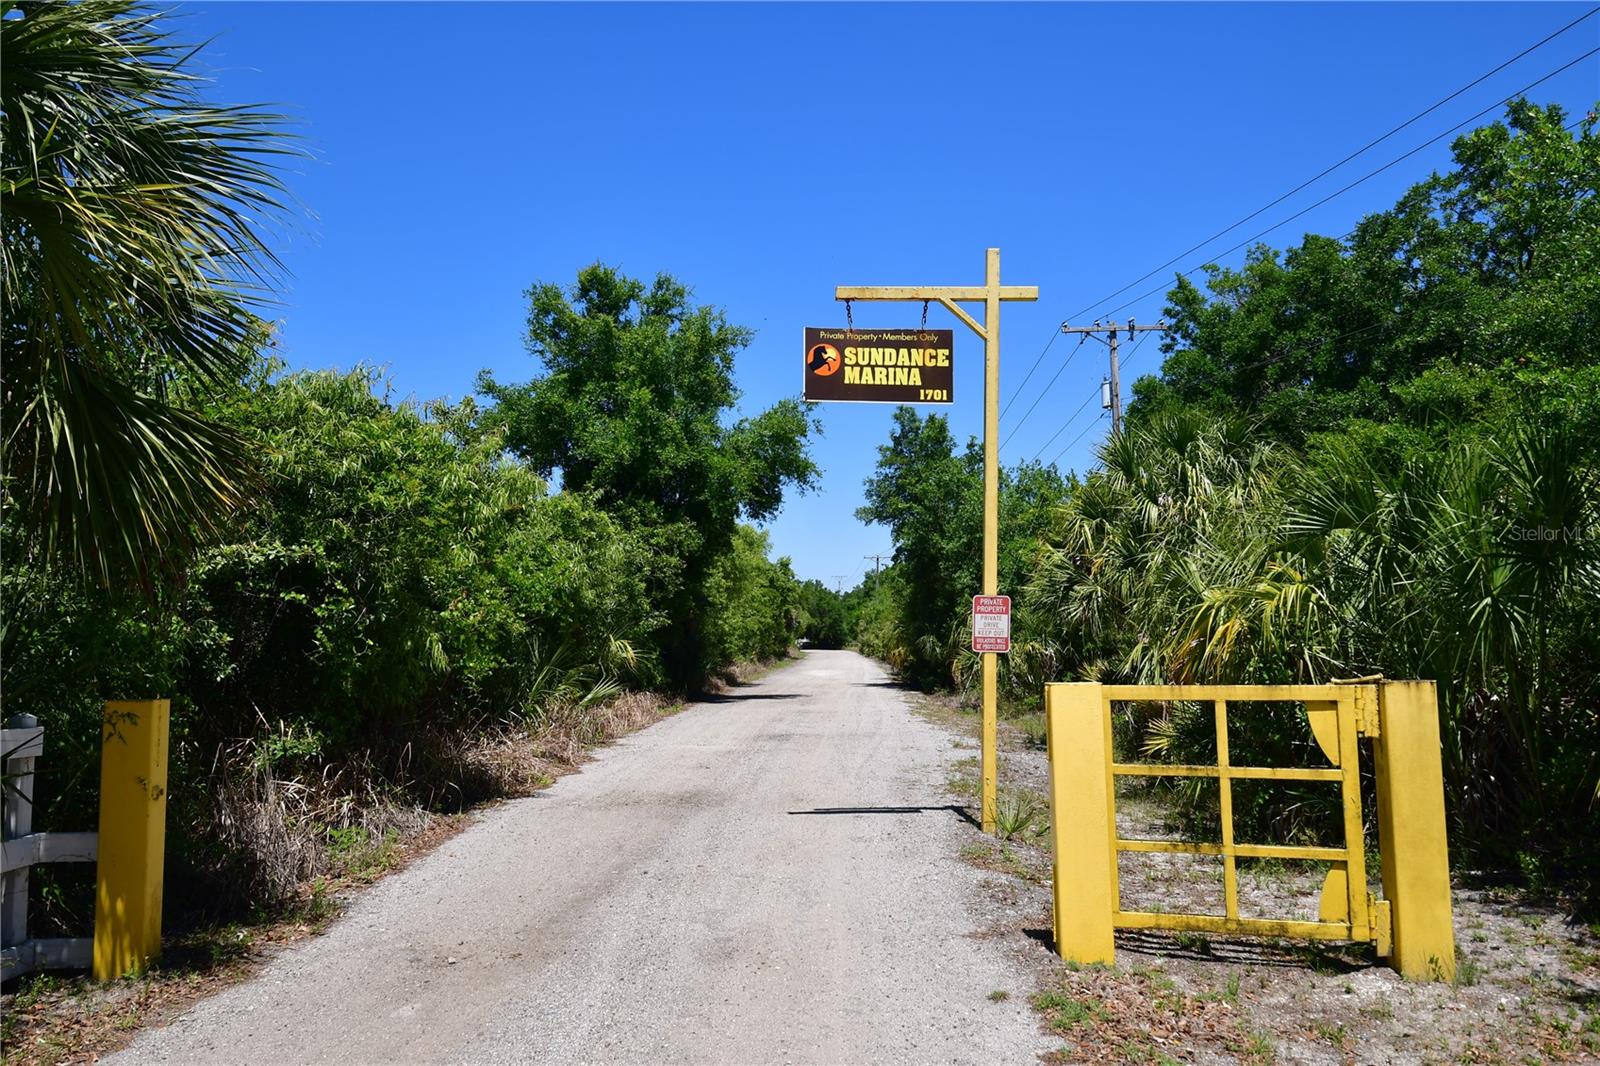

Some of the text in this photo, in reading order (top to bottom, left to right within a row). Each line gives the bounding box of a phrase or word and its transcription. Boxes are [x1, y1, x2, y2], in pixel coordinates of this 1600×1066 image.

[820, 331, 939, 343] Private Property Members Only
[844, 346, 950, 367] SUNDANCE
[844, 366, 922, 386] MARINA
[919, 389, 948, 401] 1701
[979, 598, 1003, 606] PRIVATE
[976, 605, 1006, 613] PROPERTY
